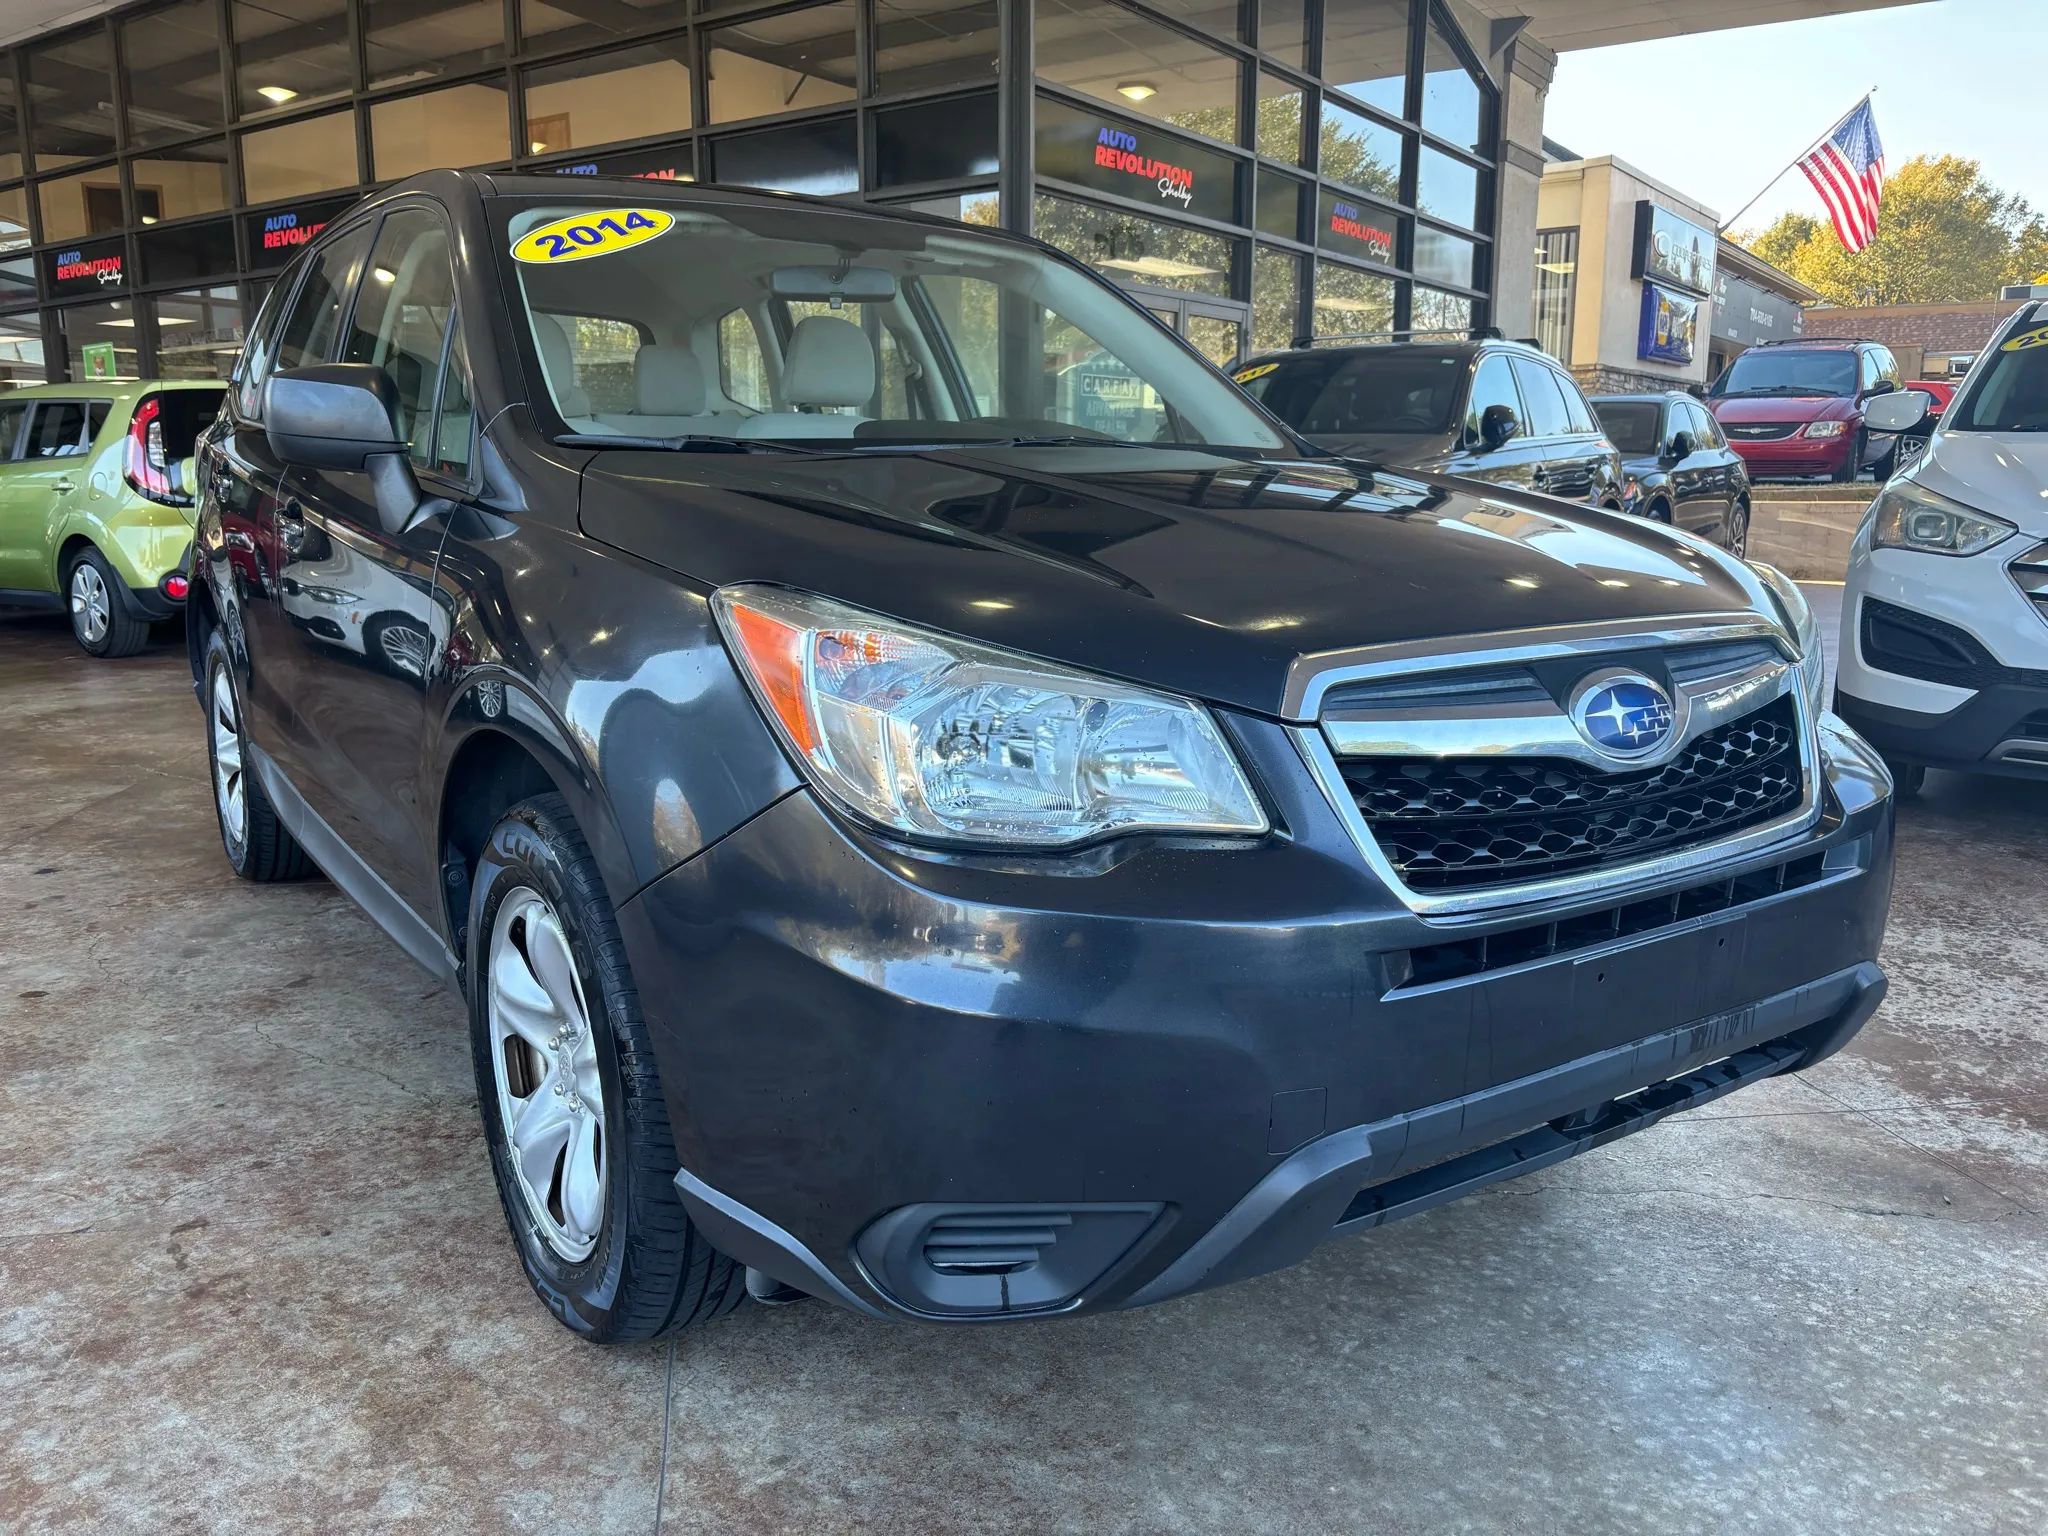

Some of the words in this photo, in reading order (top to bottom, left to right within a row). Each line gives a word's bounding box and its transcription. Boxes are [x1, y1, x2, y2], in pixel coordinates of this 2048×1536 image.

[1098, 127, 1137, 152] AUTO
[1095, 145, 1193, 189] REVOLUTION
[1157, 177, 1193, 208] Shelby
[265, 213, 297, 231] AUTO
[1333, 202, 1358, 220] AUTO
[535, 211, 657, 258] 2014
[1331, 215, 1392, 248] REVOLUTION
[57, 250, 81, 265] AUTO
[57, 256, 121, 280] REVOLUTION
[97, 266, 122, 285] Shelby
[1083, 377, 1138, 398] CARFAX
